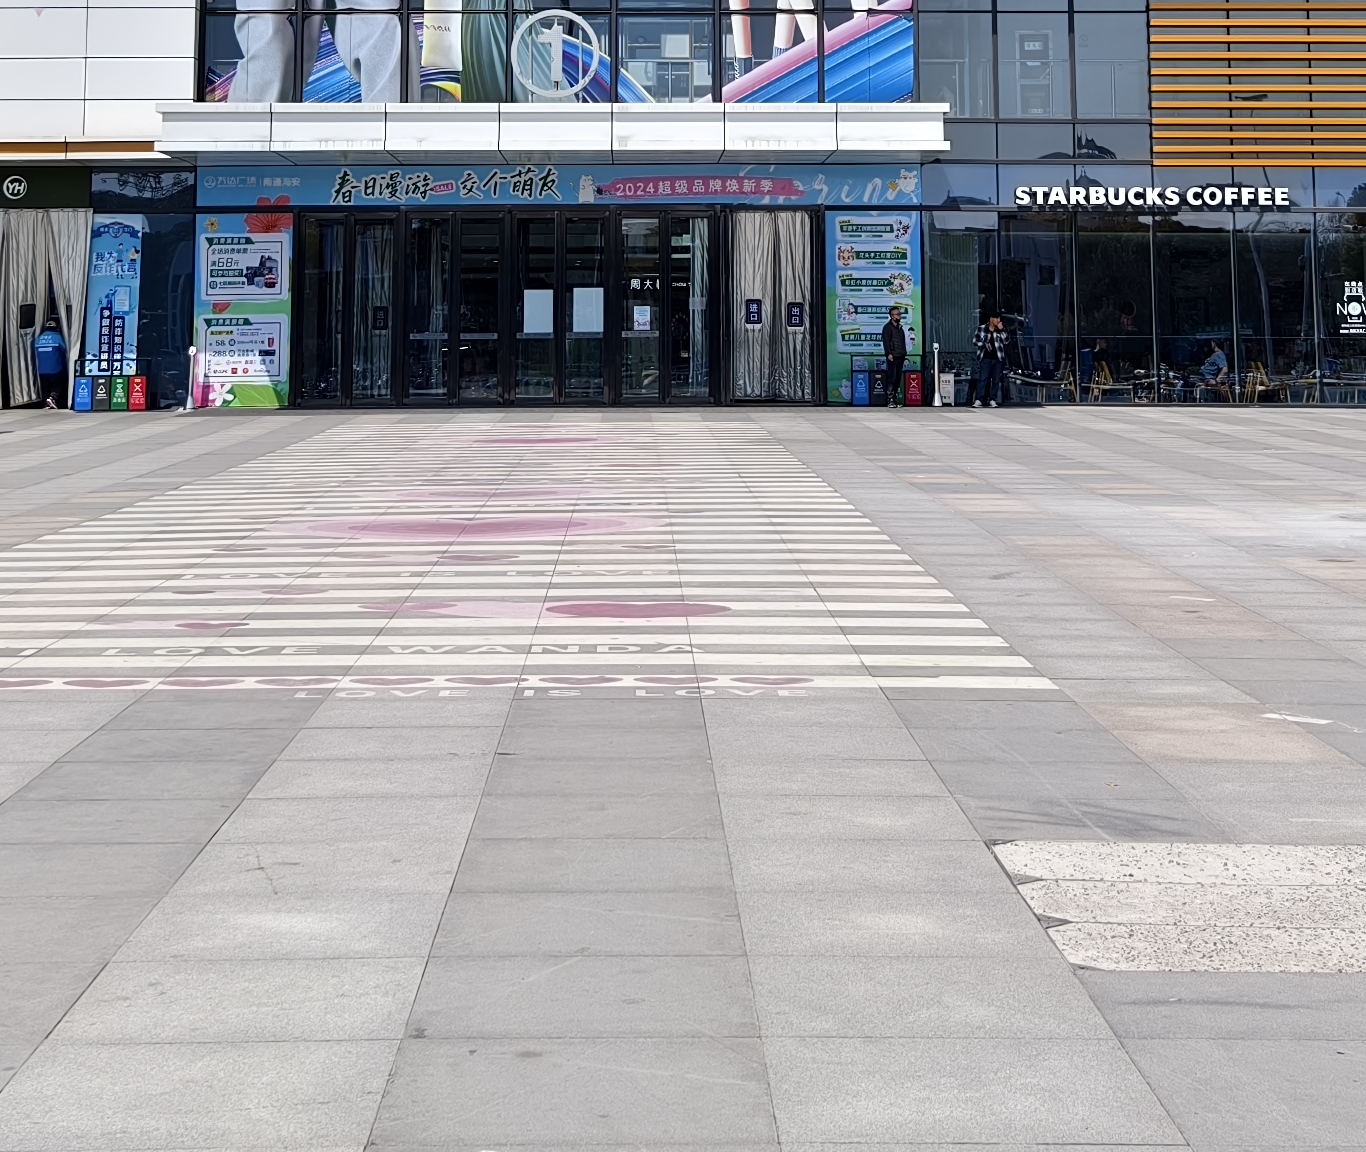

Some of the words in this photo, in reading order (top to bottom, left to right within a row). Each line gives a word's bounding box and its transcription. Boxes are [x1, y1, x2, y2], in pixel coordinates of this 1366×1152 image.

[331, 168, 432, 205] 春日漫游
[1015, 186, 1181, 207] STARBUCKS
[1185, 186, 1290, 207] COFFEE
[749, 303, 758, 321] 进口
[791, 306, 800, 324] 出口
[100, 645, 324, 656] LOVE
[386, 644, 706, 654] WANDA
[292, 689, 470, 698] LOVE
[521, 689, 583, 697] IS
[633, 689, 811, 697] LOVE
